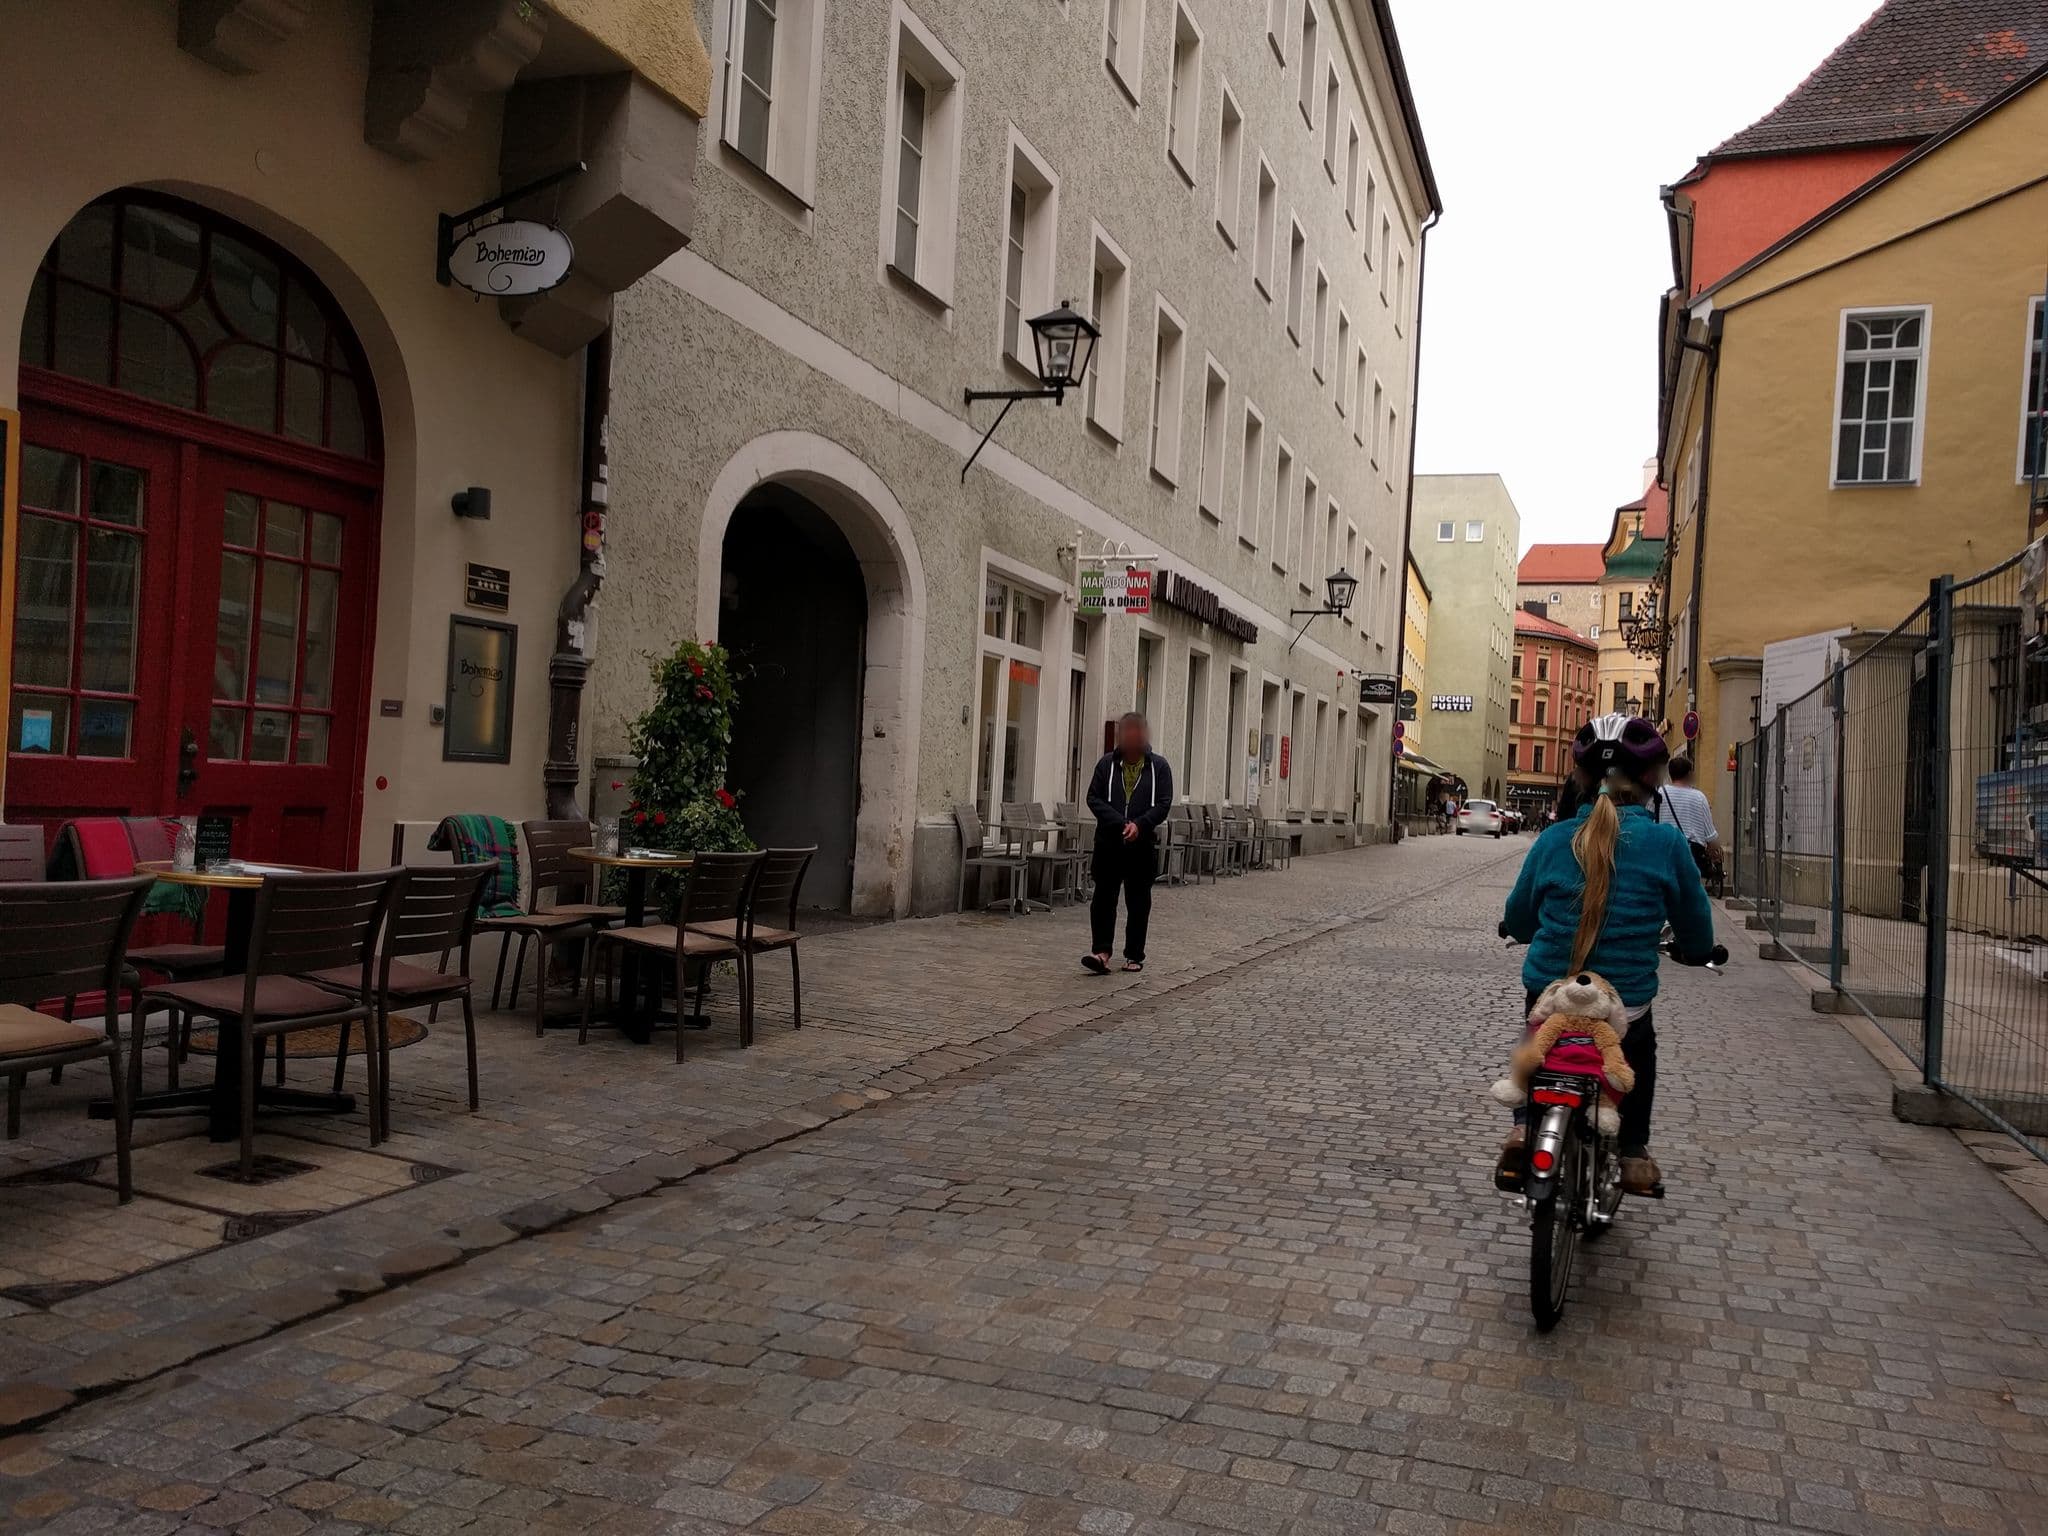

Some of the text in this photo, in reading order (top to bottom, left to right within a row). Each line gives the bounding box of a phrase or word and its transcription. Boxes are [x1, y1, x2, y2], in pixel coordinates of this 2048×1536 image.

[476, 241, 546, 266] Bohemian
[1082, 576, 1149, 589] MARADONNA
[1083, 595, 1147, 608] PIZZA & DÖNER
[460, 658, 503, 681] Bohemian
[1431, 702, 1472, 711] PUSTET
